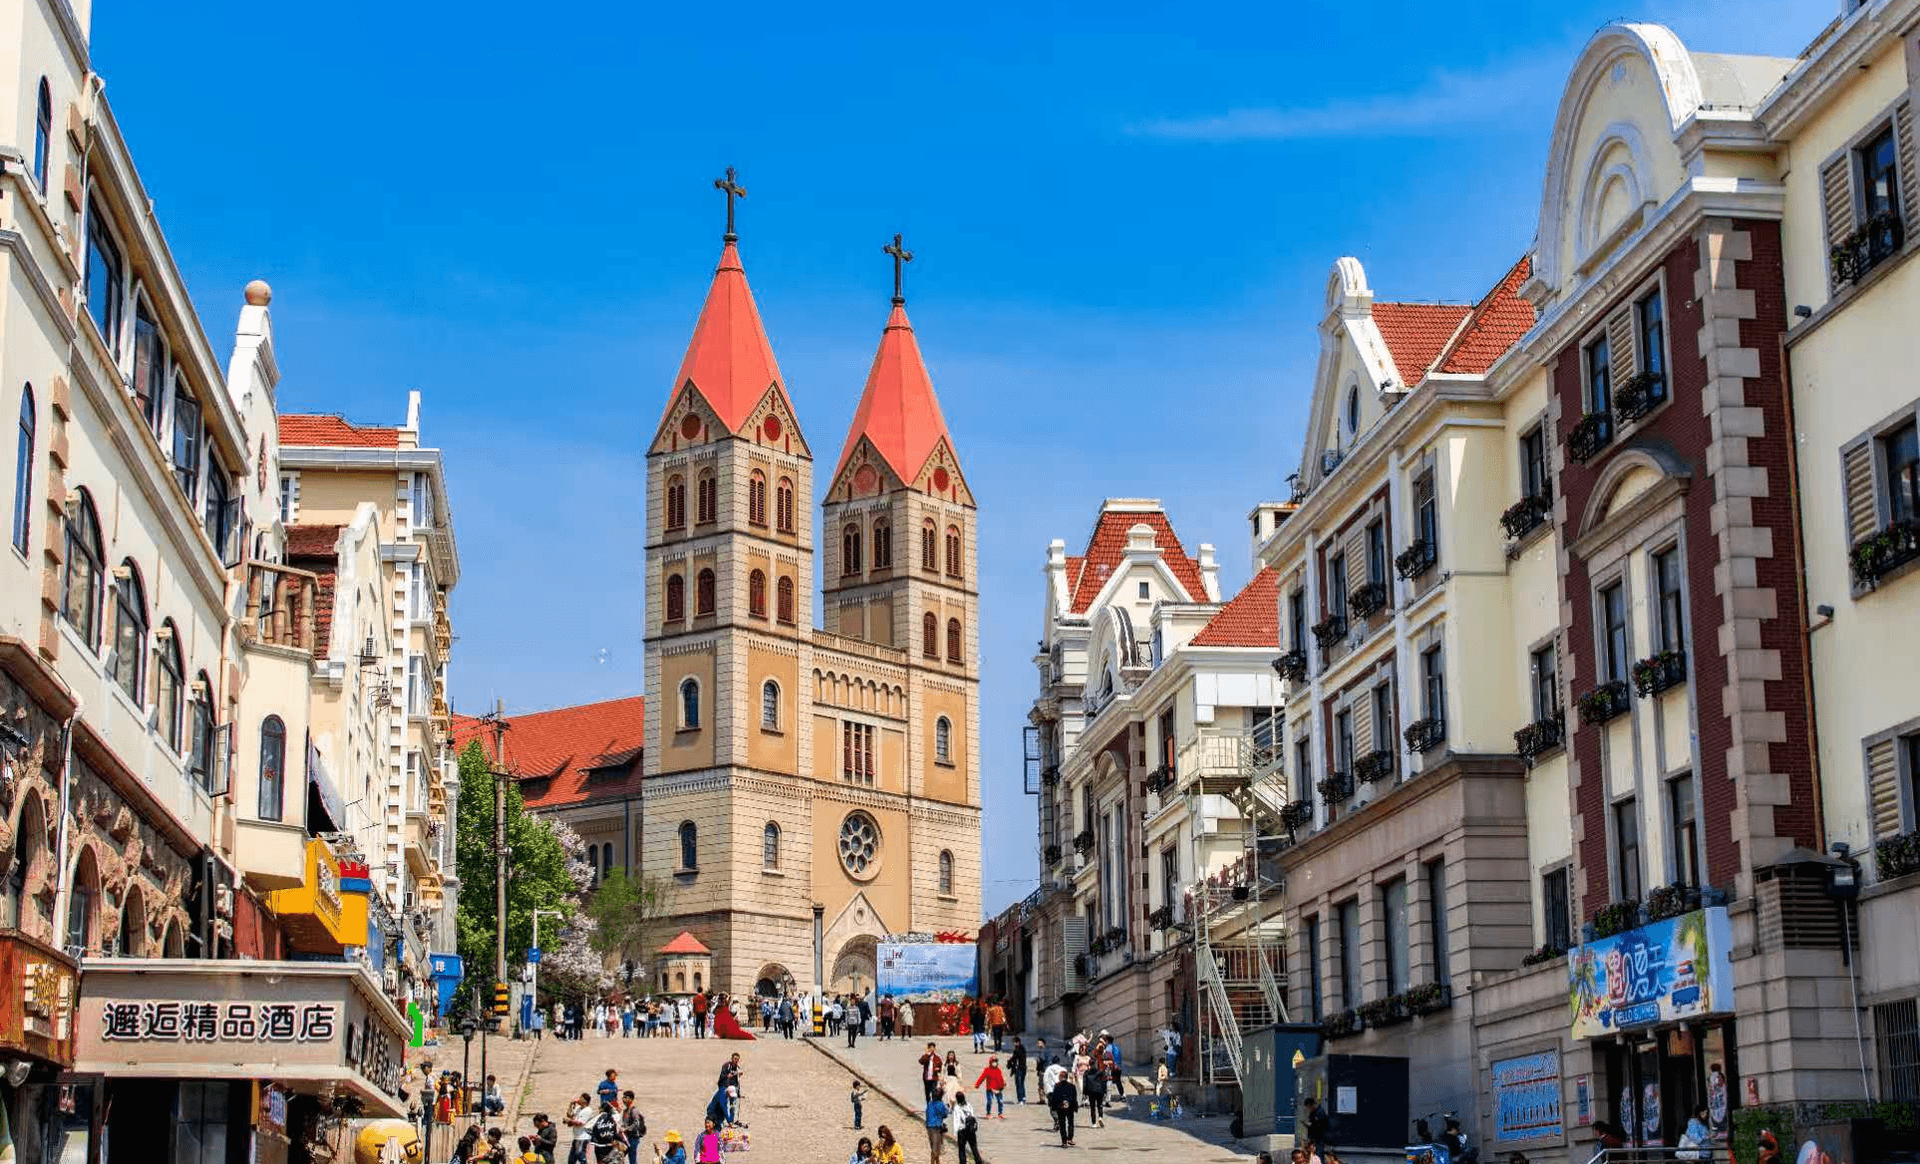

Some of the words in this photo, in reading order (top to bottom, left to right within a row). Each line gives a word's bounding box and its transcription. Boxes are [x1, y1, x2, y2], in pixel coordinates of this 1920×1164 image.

[102, 1002, 336, 1041] 邂逅精品酒店
[1615, 1008, 1633, 1024] HELLO
